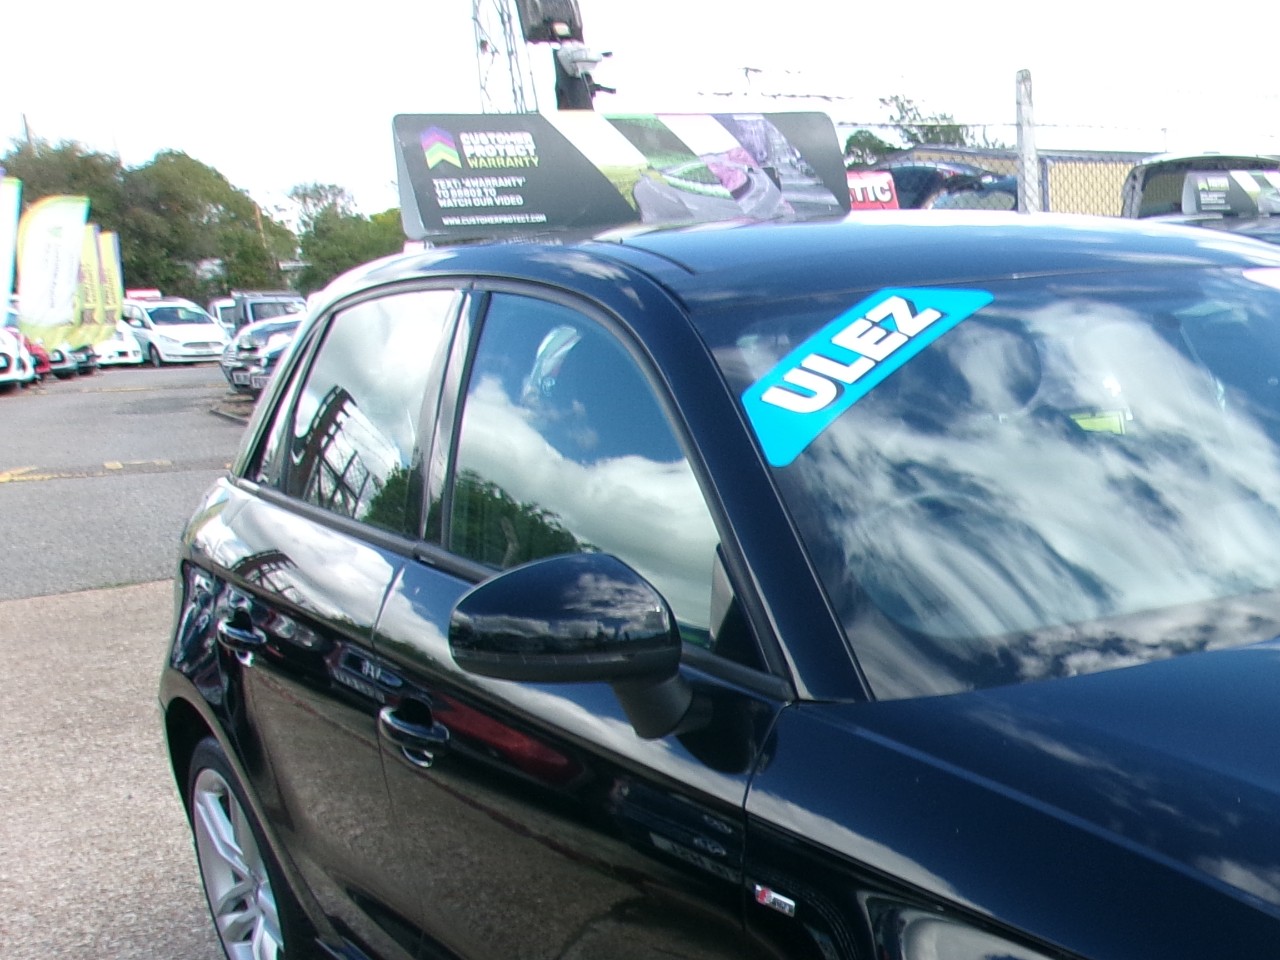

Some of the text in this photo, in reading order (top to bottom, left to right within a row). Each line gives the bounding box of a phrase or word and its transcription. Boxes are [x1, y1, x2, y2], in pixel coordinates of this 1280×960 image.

[460, 131, 535, 145] CUSTOMER
[462, 144, 537, 157] PROTECT
[467, 156, 539, 169] WARRANTY
[435, 188, 450, 198] TO
[483, 187, 497, 197] TO
[437, 194, 524, 208] WATCH OUR VIDEO
[761, 295, 948, 413] ULEZ
